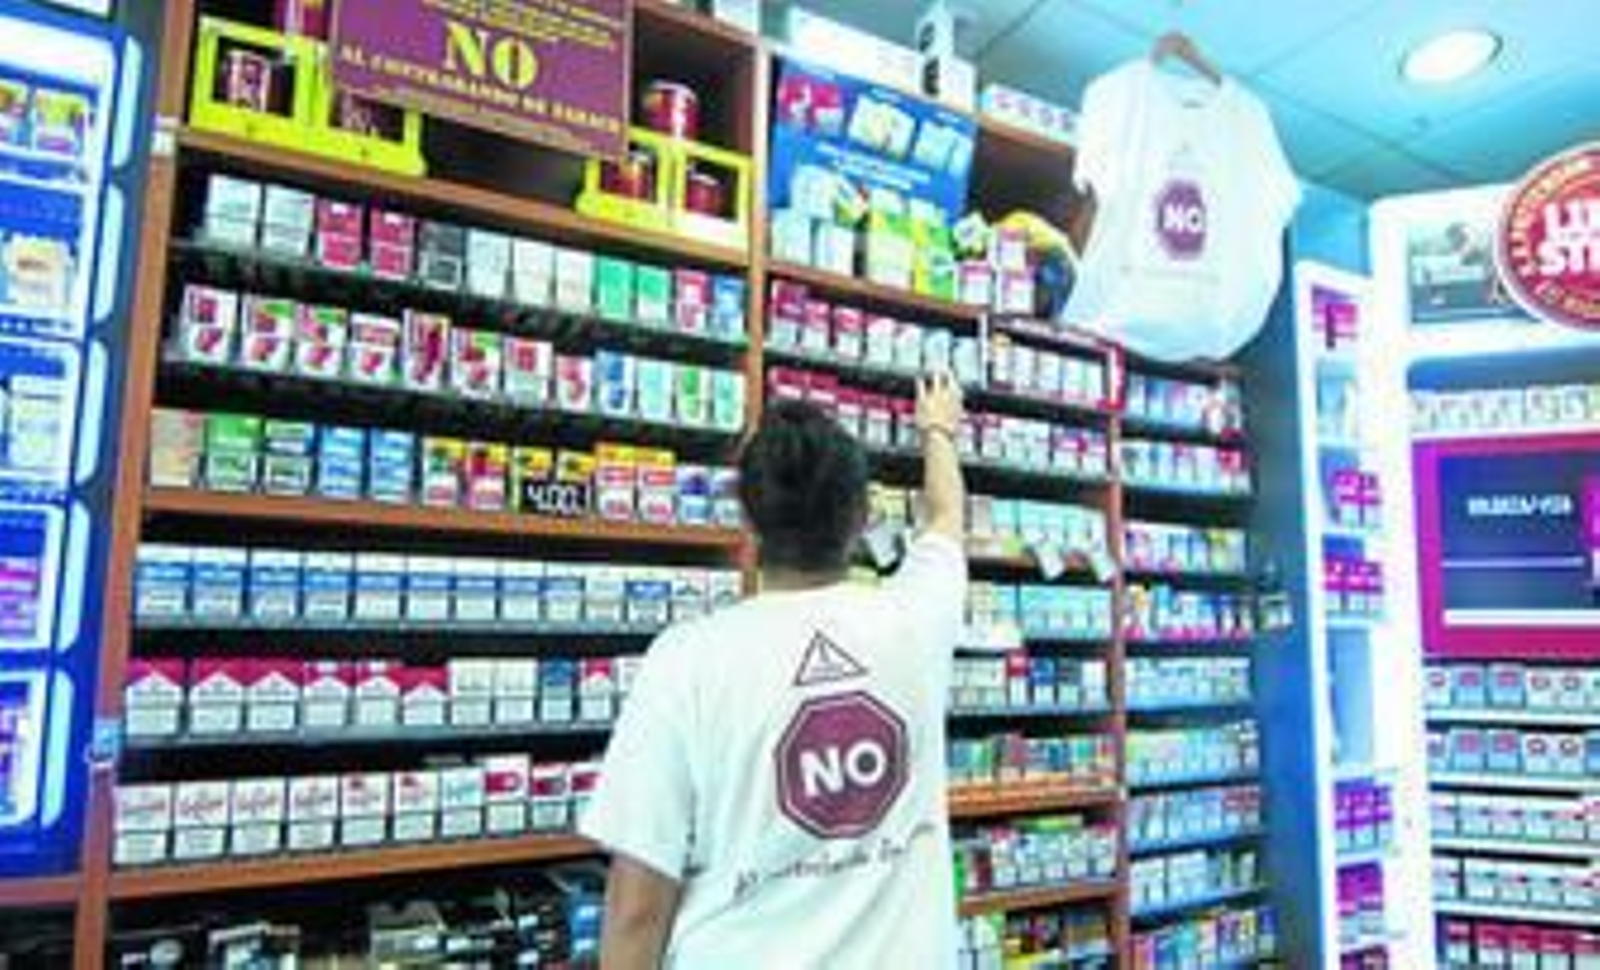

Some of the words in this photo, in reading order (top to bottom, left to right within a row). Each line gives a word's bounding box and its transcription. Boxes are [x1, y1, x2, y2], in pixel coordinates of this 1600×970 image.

[444, 20, 538, 89] NO
[1162, 203, 1204, 235] NO
[799, 738, 888, 799] NO
